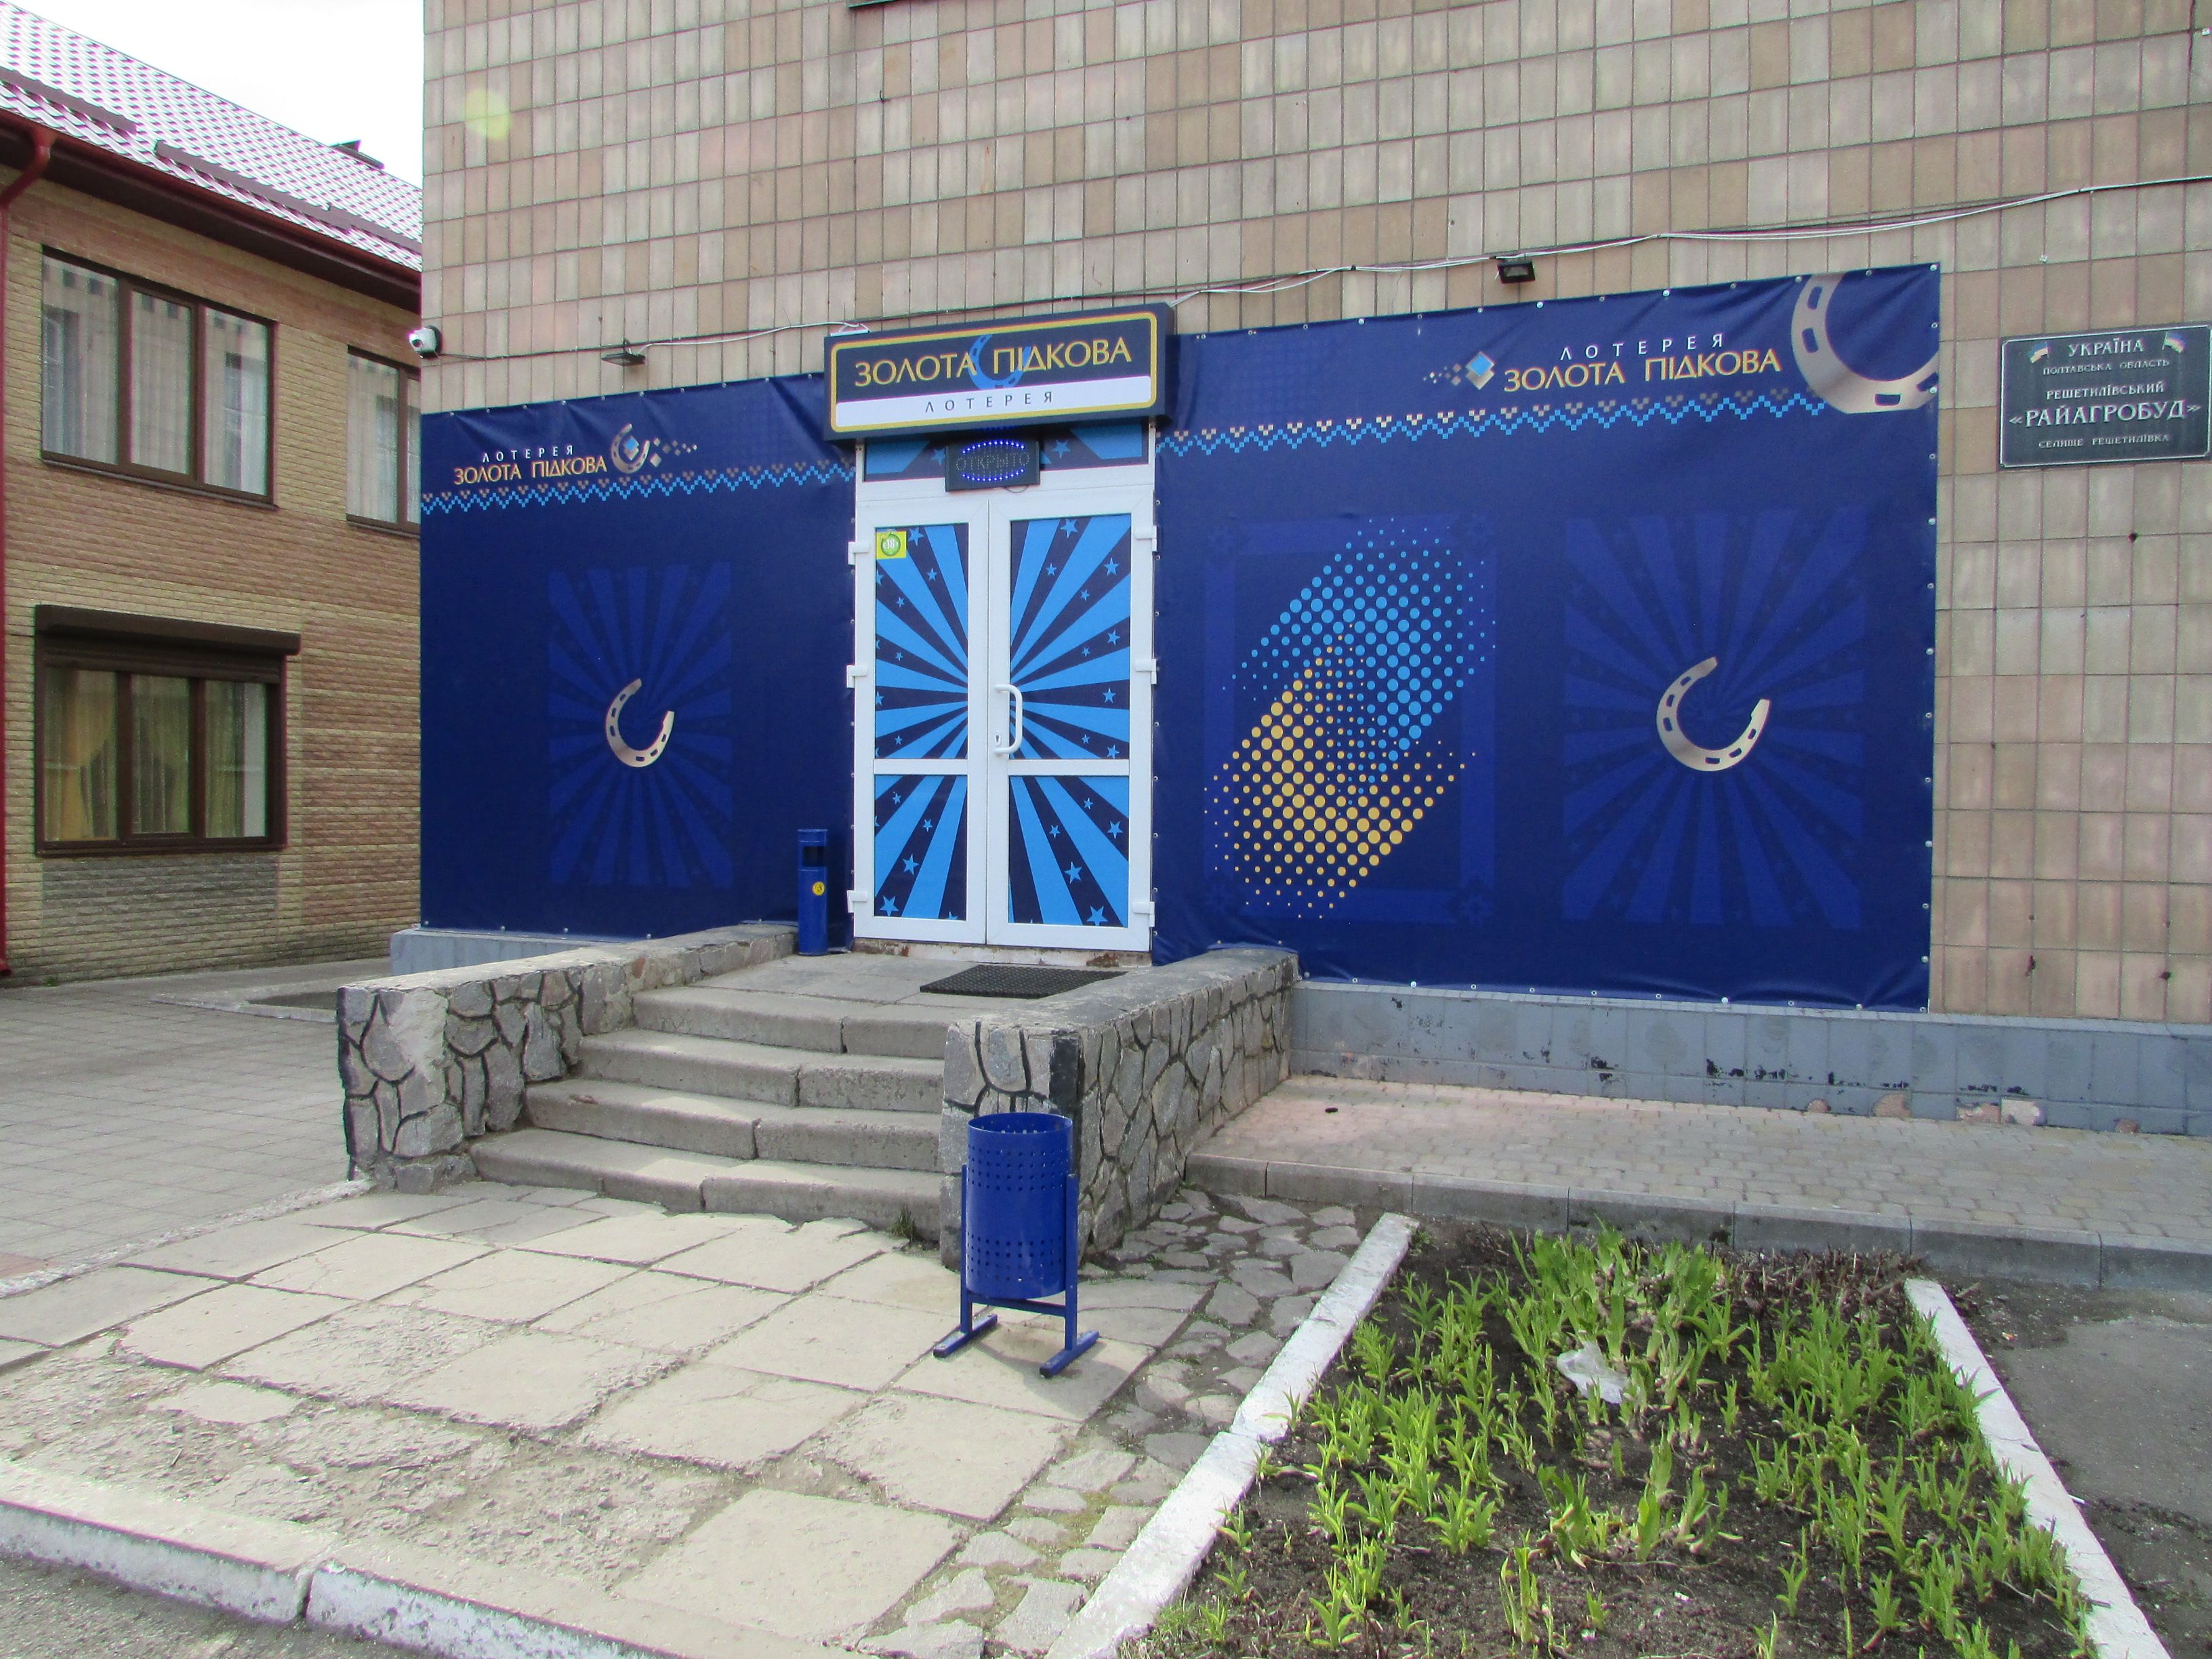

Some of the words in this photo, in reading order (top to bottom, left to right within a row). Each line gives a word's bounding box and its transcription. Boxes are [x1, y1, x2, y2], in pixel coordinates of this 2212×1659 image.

[1560, 333, 1723, 361] ЛОТЕРЕЯ
[2068, 337, 2145, 357] УКРАЇНА
[855, 352, 977, 387] ЗОЛОТА
[994, 337, 1132, 374] ПІДКОВА
[1503, 362, 1625, 392] ЗОЛОТА
[1643, 348, 1781, 382] ПІДКОВА
[2043, 363, 2112, 375] ПОЛТАВСЬКА
[2119, 359, 2169, 369] ОБЛАСТЬ
[2046, 380, 2165, 400] РЕШЕТИЛІВСЬКИЙ
[925, 391, 1052, 413] ЛОТЕРЕЯ
[2009, 400, 2201, 428] «РАЙАГРОБУД»
[2039, 438, 2083, 449] СЕЛИЩЕ
[2092, 434, 2169, 446] РЕШЕТИЛІВКА
[482, 445, 573, 463] ЛОТЕРЕЯ
[956, 452, 1029, 472] ОТКРЫТО
[454, 464, 522, 485] ЗОЛОТА
[531, 455, 607, 478] ПІДКОВА
